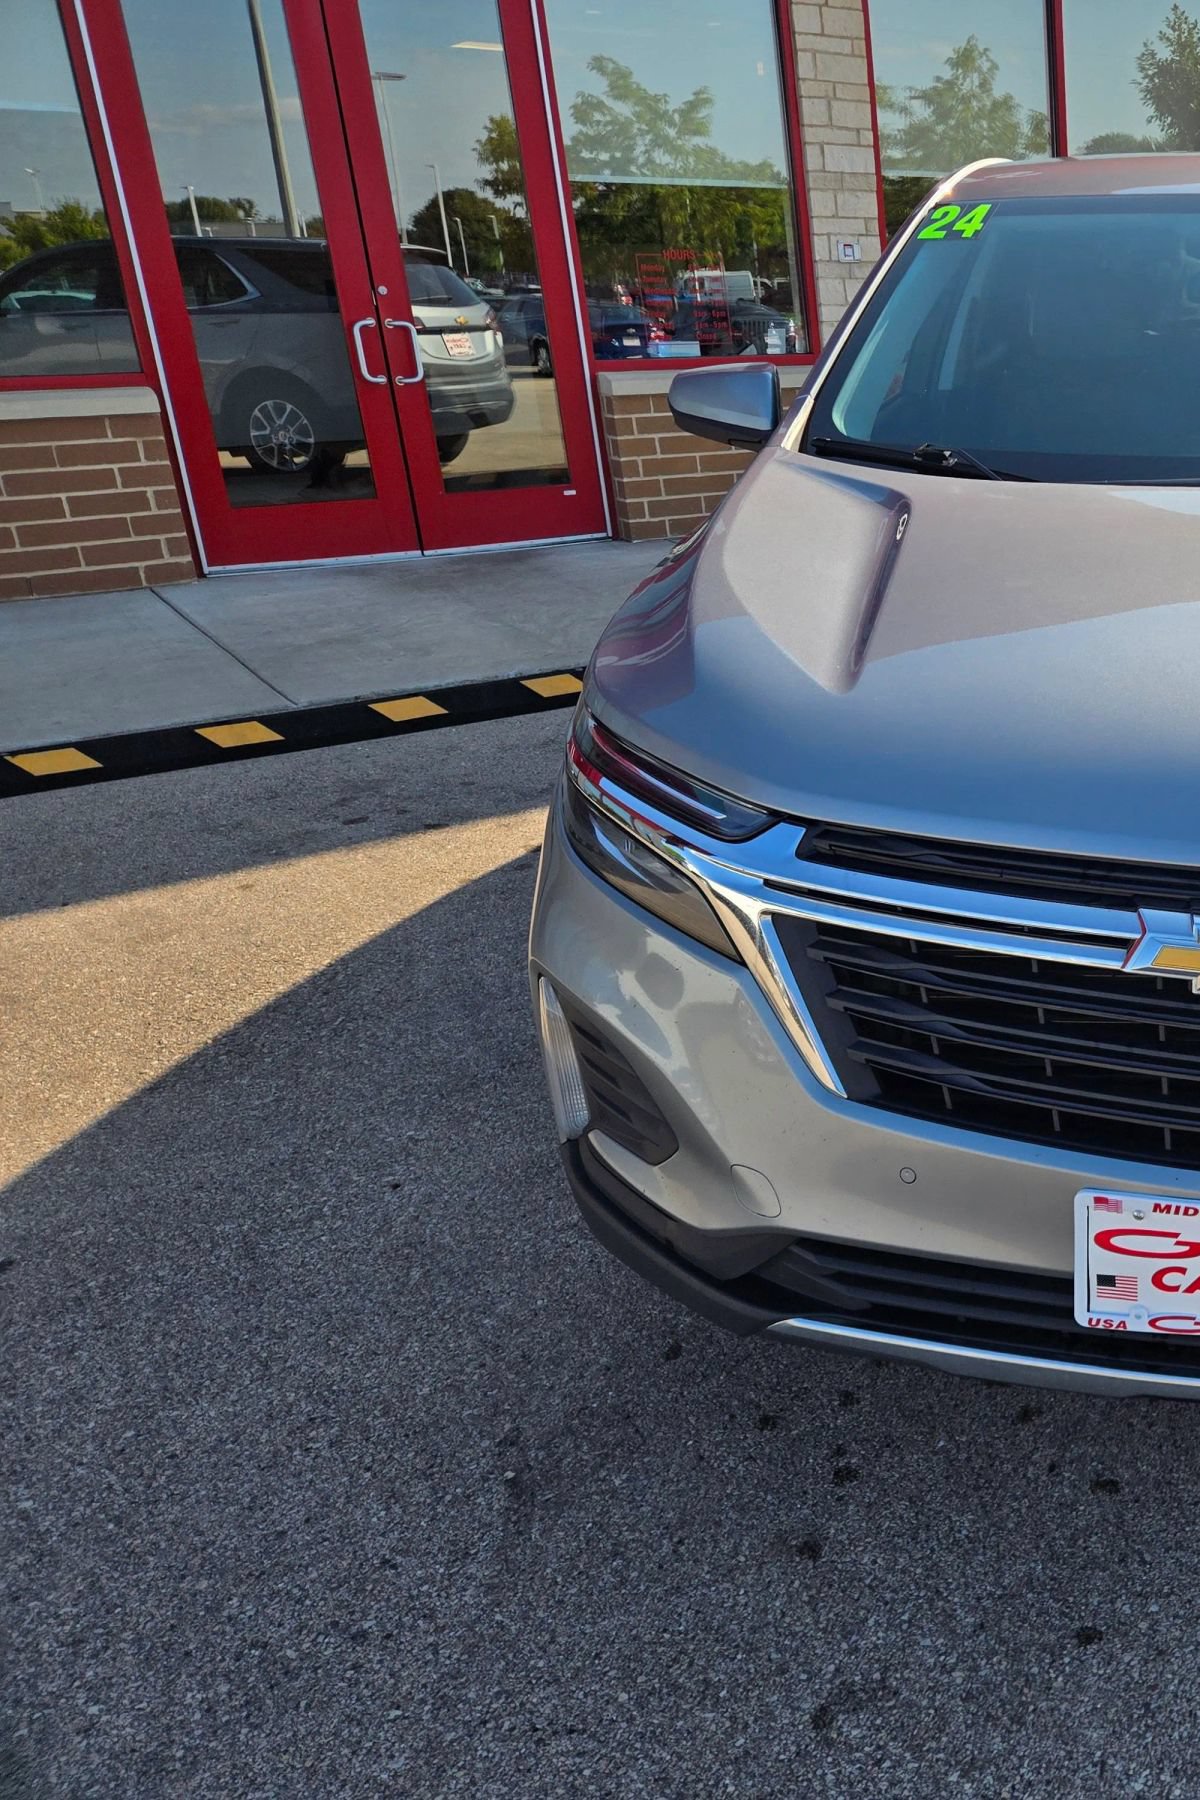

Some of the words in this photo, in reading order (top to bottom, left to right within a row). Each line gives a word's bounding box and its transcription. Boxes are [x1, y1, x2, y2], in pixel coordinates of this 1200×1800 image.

[917, 204, 992, 239] 24
[663, 249, 696, 260] HOURS
[1087, 1317, 1128, 1330] USA
